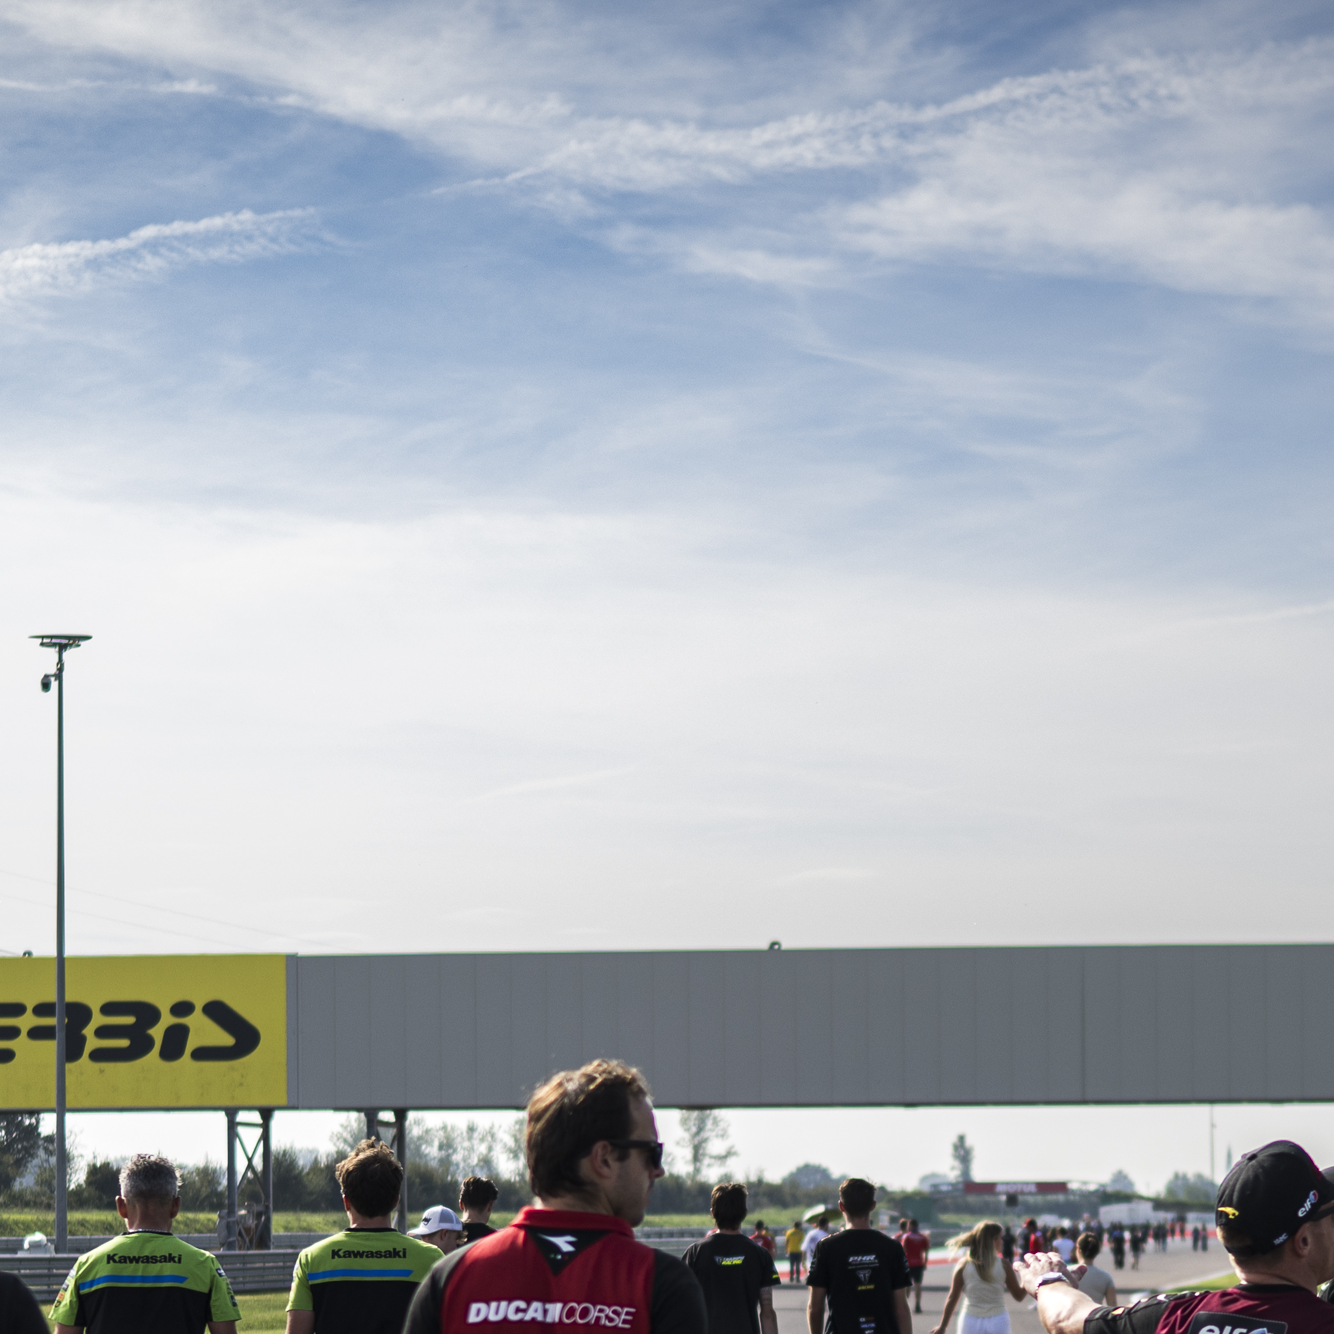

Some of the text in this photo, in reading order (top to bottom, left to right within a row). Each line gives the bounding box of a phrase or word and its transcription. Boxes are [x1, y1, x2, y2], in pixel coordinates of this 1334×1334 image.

[995, 1182, 1037, 1193] MOTUL
[1297, 1198, 1312, 1217] elf
[106, 1253, 182, 1264] Kawasaki
[331, 1248, 407, 1259] Kawasaki
